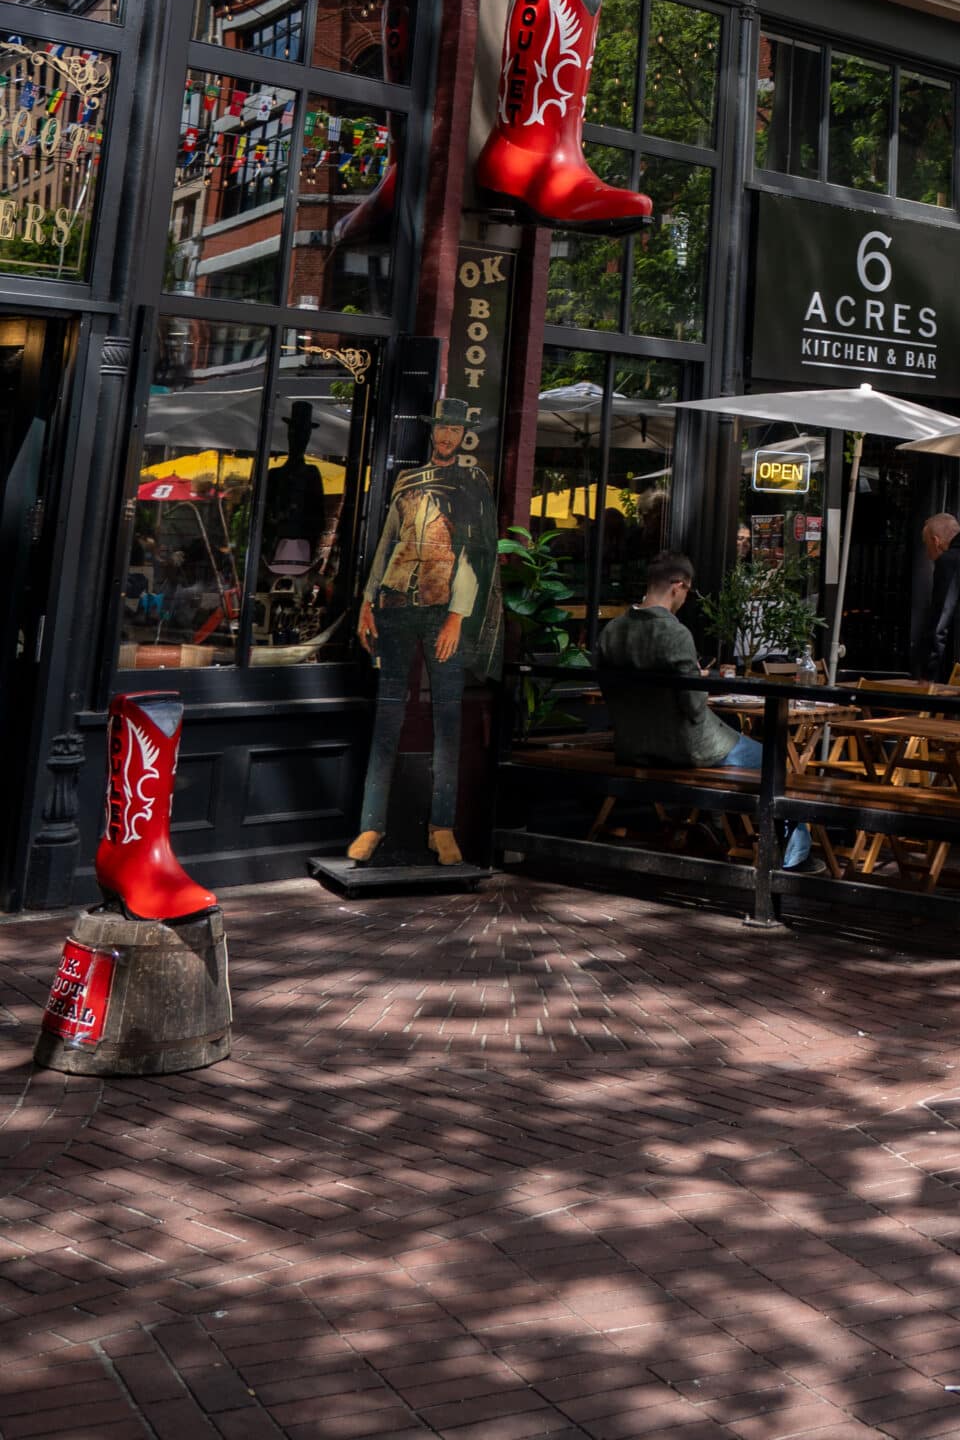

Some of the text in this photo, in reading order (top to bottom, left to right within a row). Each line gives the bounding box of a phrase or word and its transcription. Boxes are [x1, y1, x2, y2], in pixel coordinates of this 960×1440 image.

[459, 255, 506, 288] OK
[857, 230, 893, 293] 6
[804, 291, 937, 338] ACRES
[464, 298, 490, 388] BOOT
[802, 338, 936, 370] KITCHEN & BAR
[759, 462, 804, 481] OPEN
[110, 714, 123, 845] BOULET
[52, 976, 87, 1001] OOT
